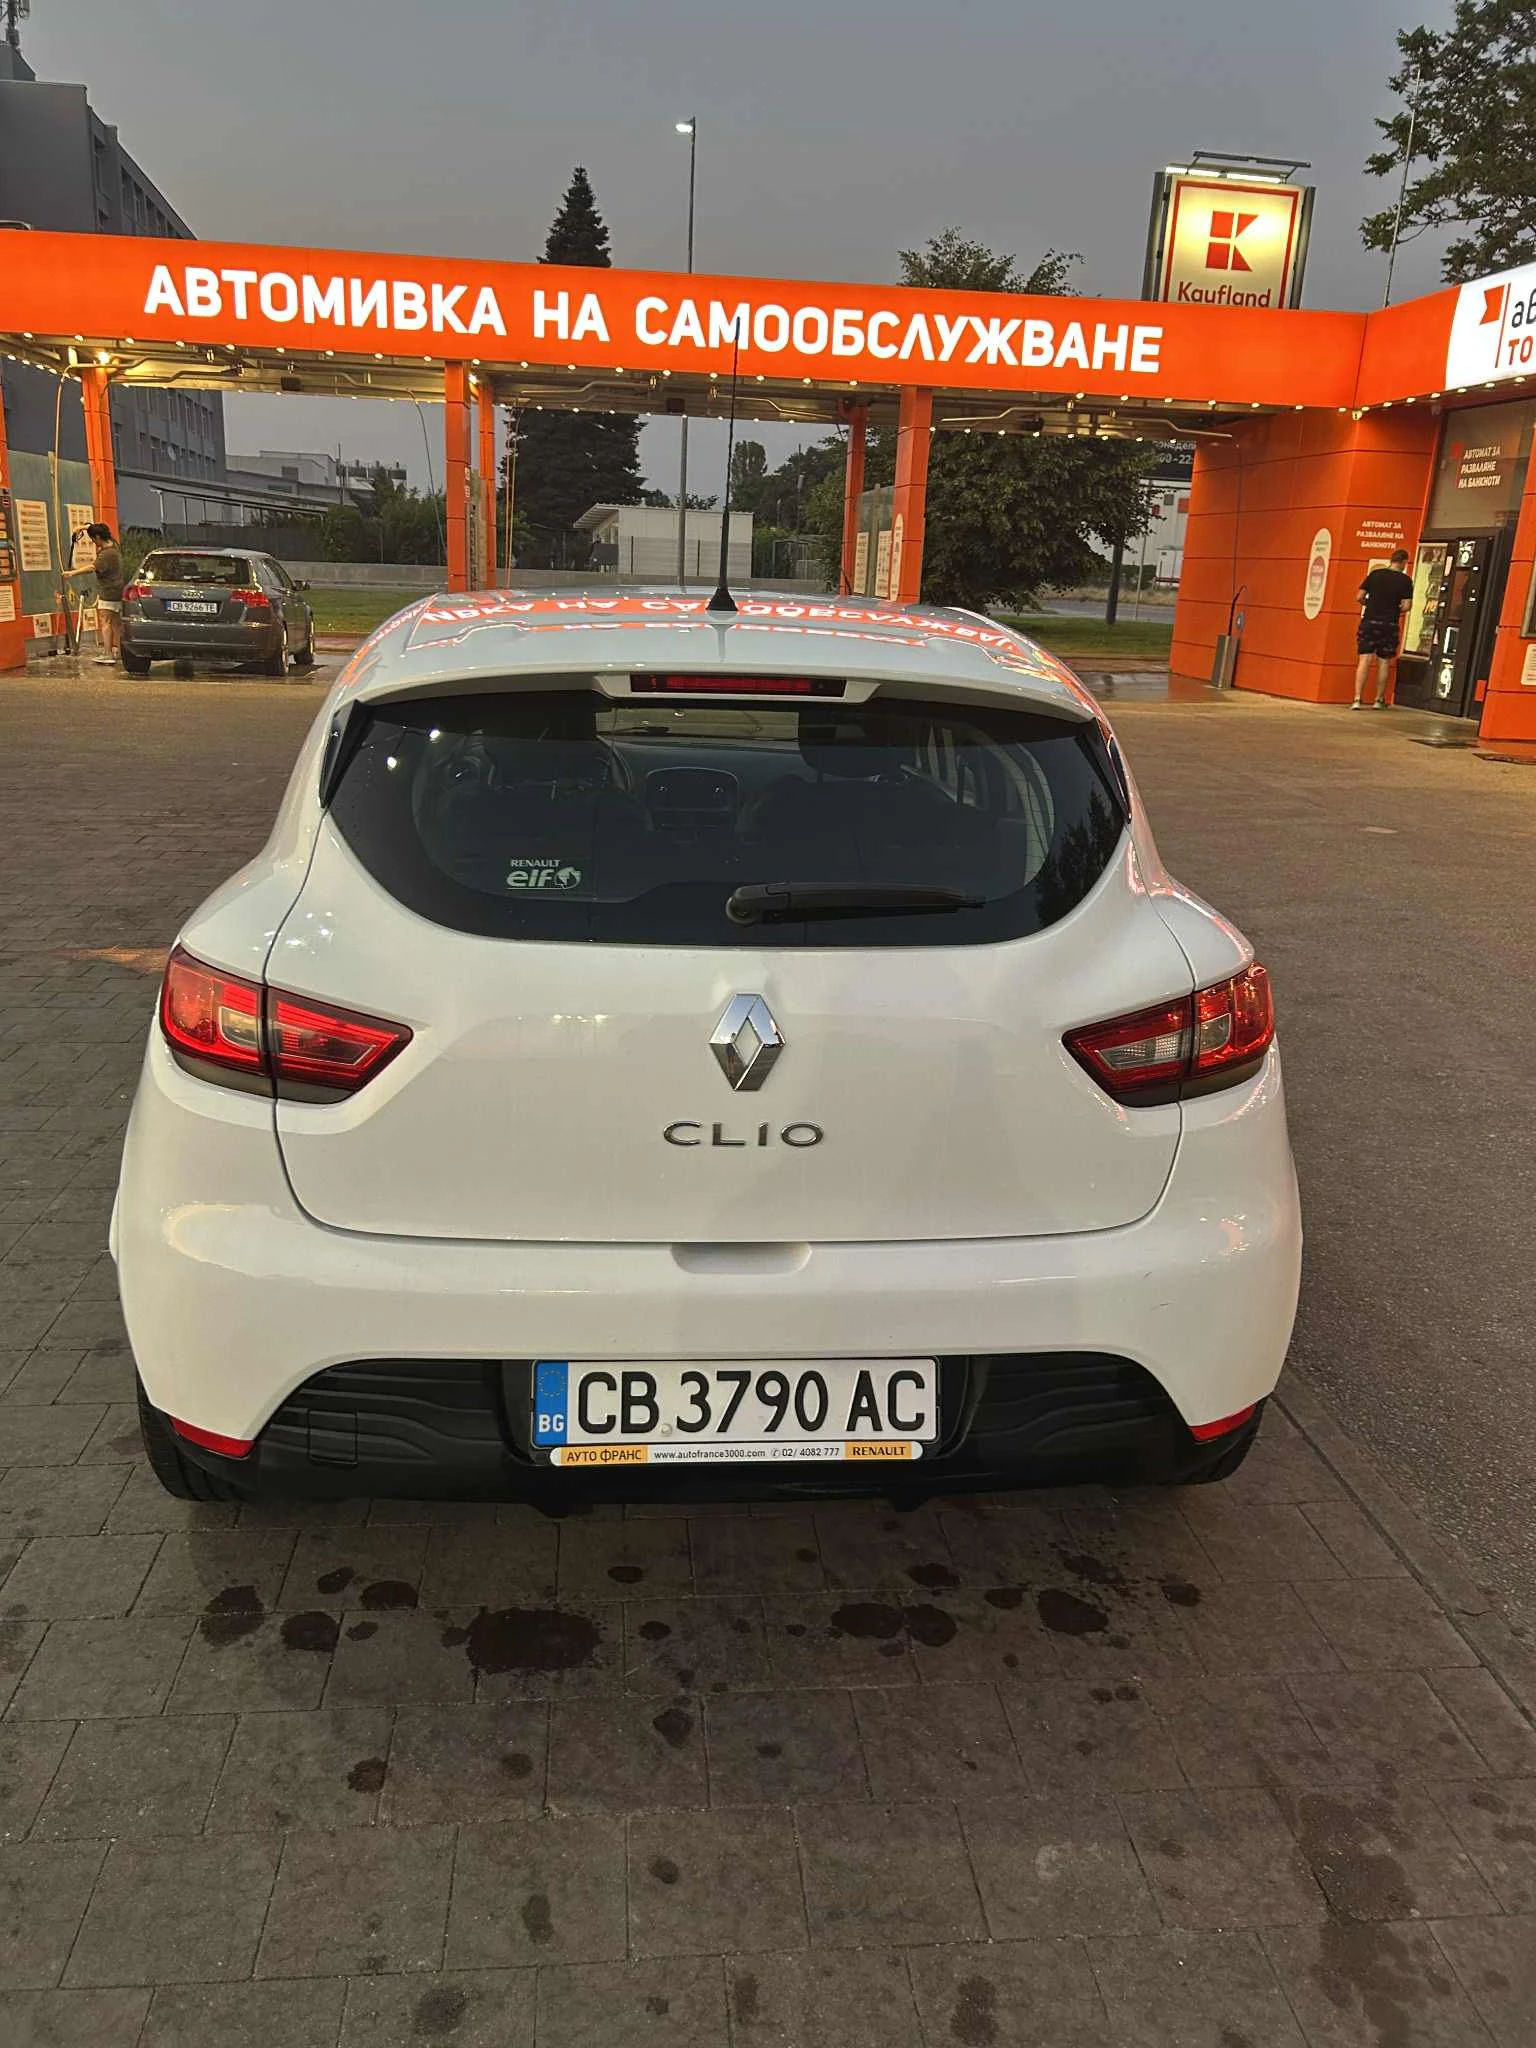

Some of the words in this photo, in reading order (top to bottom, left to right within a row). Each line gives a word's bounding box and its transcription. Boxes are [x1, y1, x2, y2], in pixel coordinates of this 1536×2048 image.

[1178, 281, 1271, 307] Kaufland
[145, 266, 506, 335] АВТОМИВКА
[534, 291, 609, 341] НА
[636, 297, 1162, 372] САМООБСЛУЖВАНЕ
[510, 859, 561, 868] RENAULT
[506, 869, 554, 887] elf
[663, 1121, 824, 1147] CLIO
[538, 1413, 565, 1433] BG
[578, 1371, 660, 1434] CB
[676, 1371, 828, 1433] 3790
[845, 1369, 926, 1432] AC
[566, 1450, 597, 1463] АУТО
[600, 1449, 642, 1463] ФРАНС
[654, 1448, 766, 1460] www.autofrance3000.com
[800, 1447, 822, 1457] 4082
[824, 1446, 840, 1456] 777
[852, 1446, 906, 1456] RENAULT
